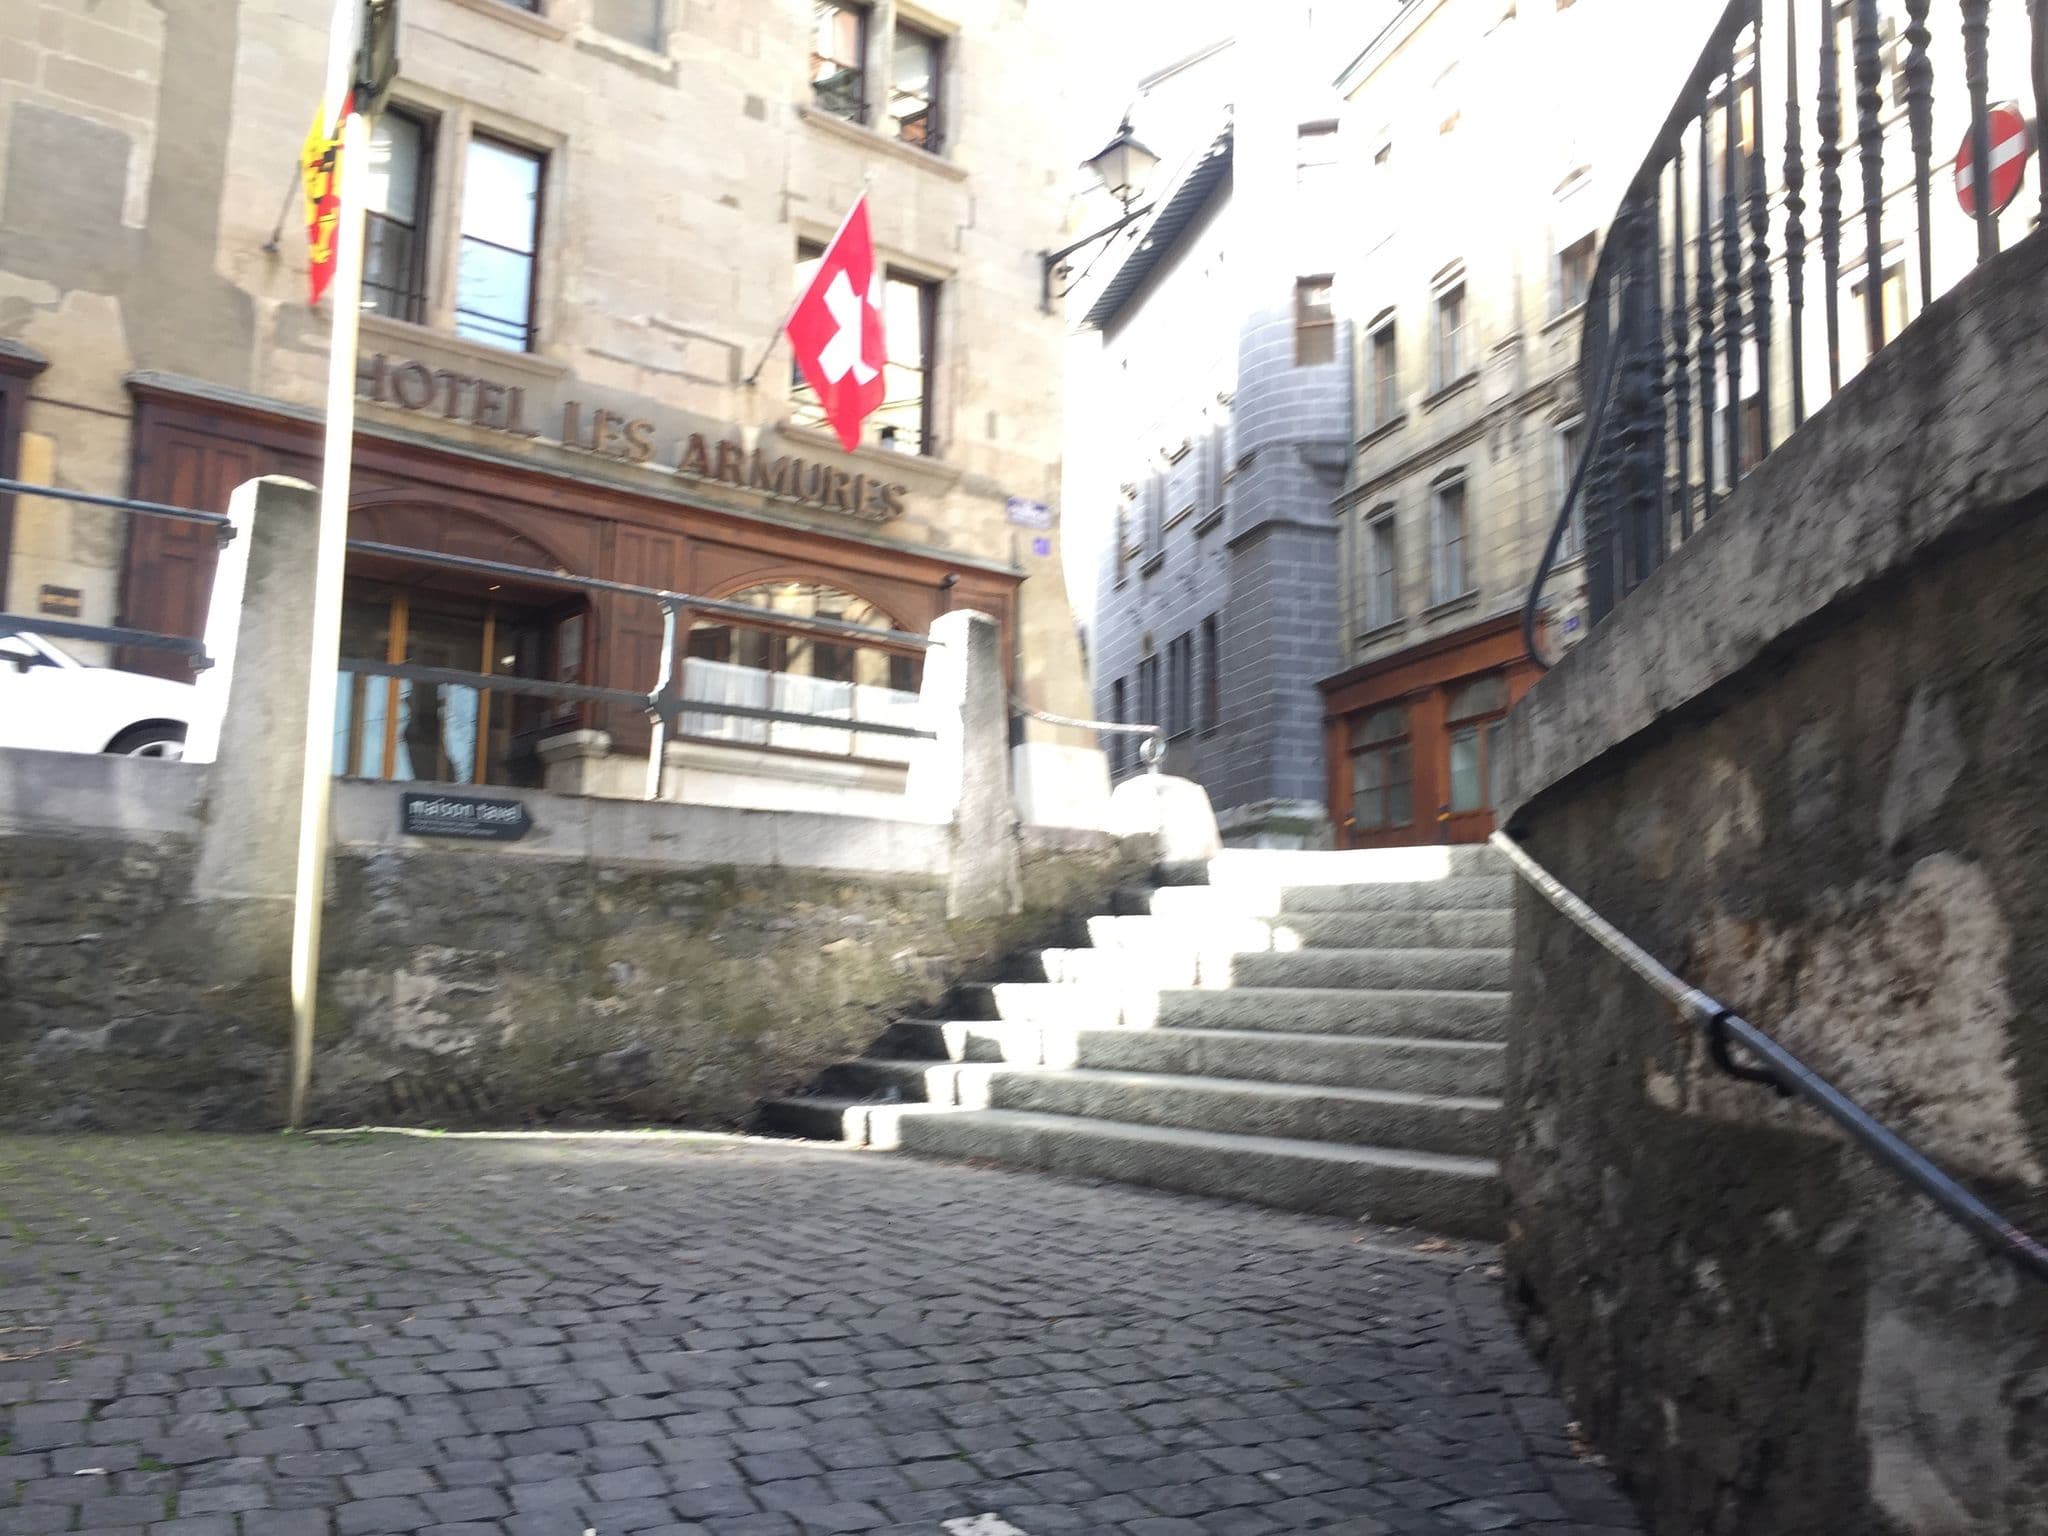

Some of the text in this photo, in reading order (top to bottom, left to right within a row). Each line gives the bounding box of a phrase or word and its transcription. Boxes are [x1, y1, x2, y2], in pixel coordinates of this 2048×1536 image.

[356, 353, 906, 522] HOTEL LES ARMURES
